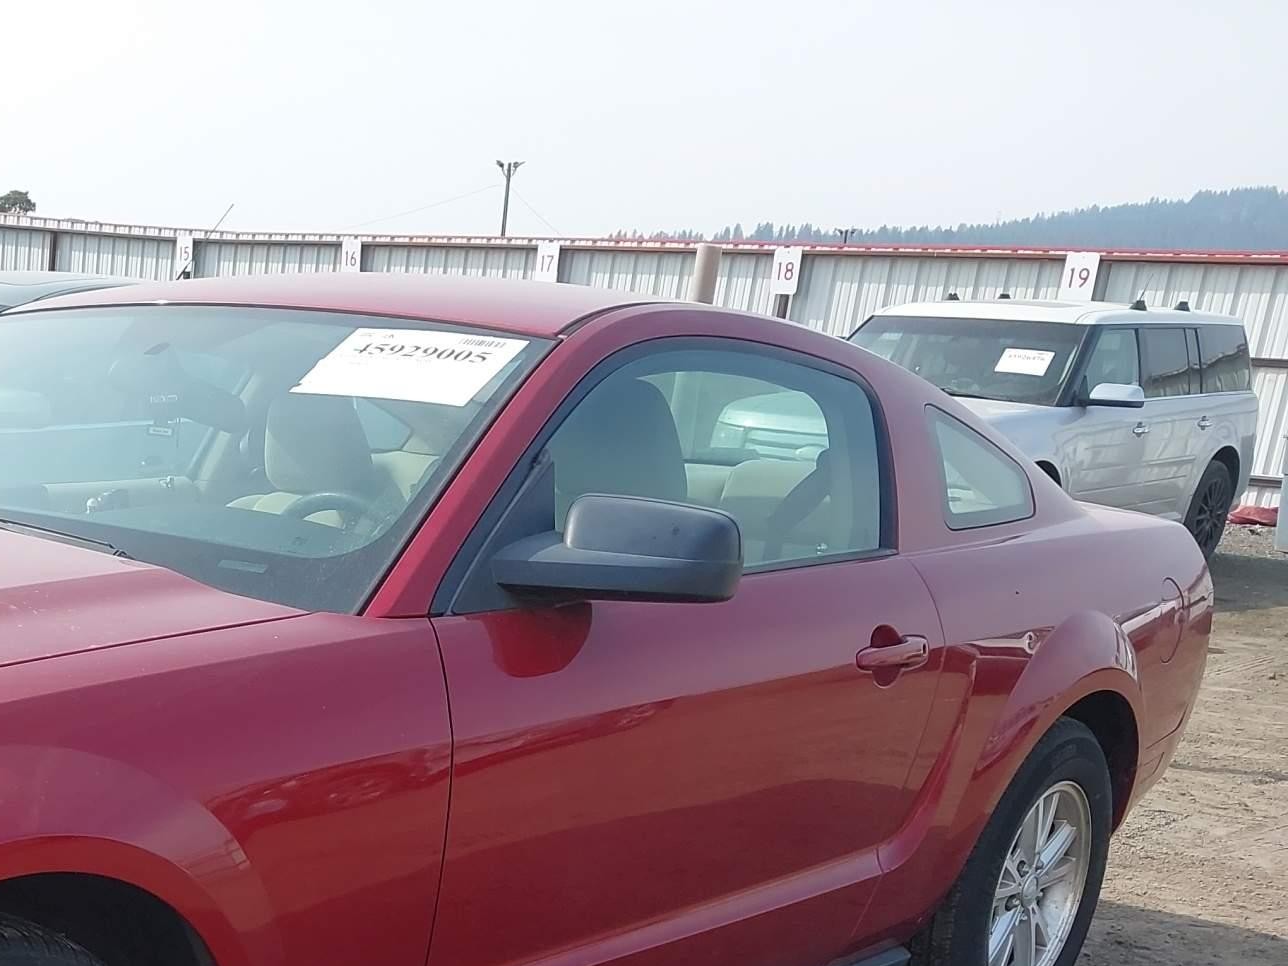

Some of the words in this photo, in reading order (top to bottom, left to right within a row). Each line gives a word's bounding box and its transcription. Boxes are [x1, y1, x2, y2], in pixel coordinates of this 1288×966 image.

[179, 247, 190, 261] 15
[345, 250, 357, 267] 16
[541, 255, 554, 272] 17
[777, 262, 794, 280] 18
[1068, 267, 1090, 289] 19
[353, 342, 493, 363] 45929005
